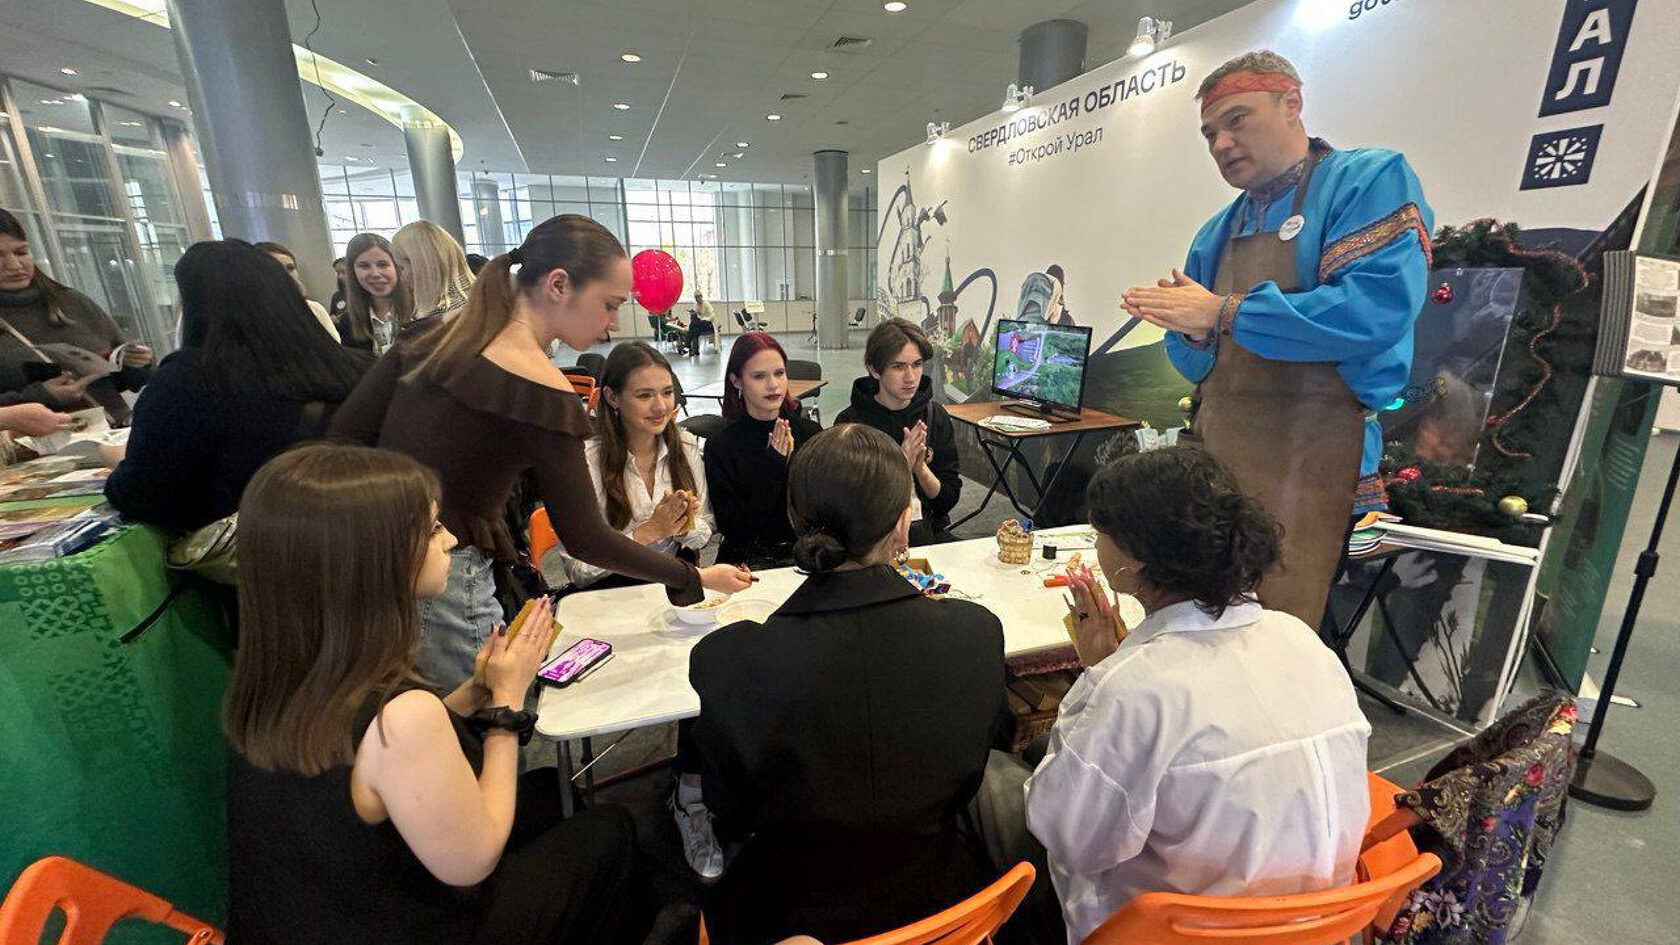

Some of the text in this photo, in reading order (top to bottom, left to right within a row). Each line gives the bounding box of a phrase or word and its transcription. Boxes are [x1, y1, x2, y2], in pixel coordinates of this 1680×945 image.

[968, 60, 1187, 153] СВЕРДЛОВСКАЯ ОБЛАСТЬ
[1008, 127, 1103, 166] #Открой Урал
